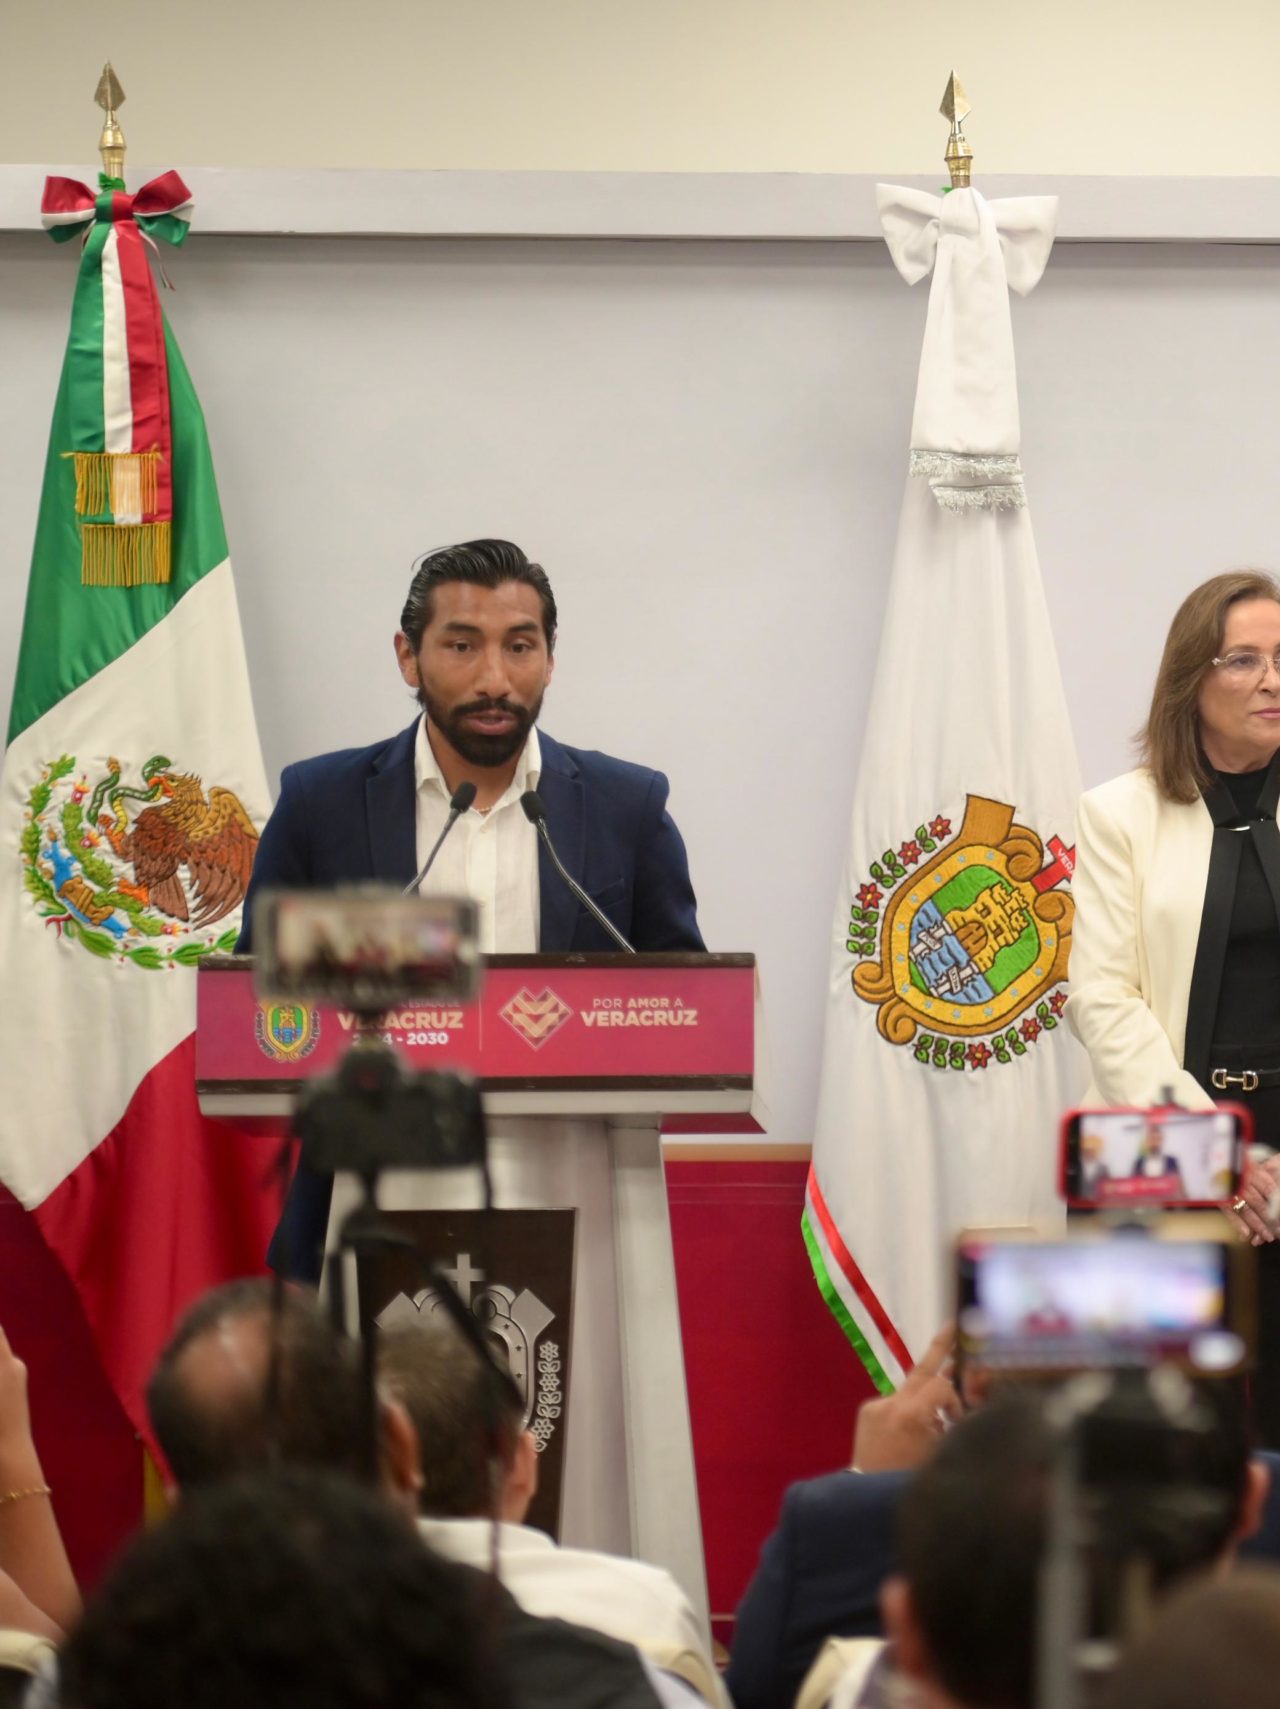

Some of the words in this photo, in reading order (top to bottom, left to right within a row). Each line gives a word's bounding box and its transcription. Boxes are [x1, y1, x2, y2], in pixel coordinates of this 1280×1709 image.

[1058, 847, 1074, 875] VER
[592, 998, 623, 1009] POR
[627, 998, 670, 1009] AMOR
[673, 998, 684, 1008] A
[580, 1010, 699, 1027] VERACRUZ
[406, 1031, 449, 1045] 2030
